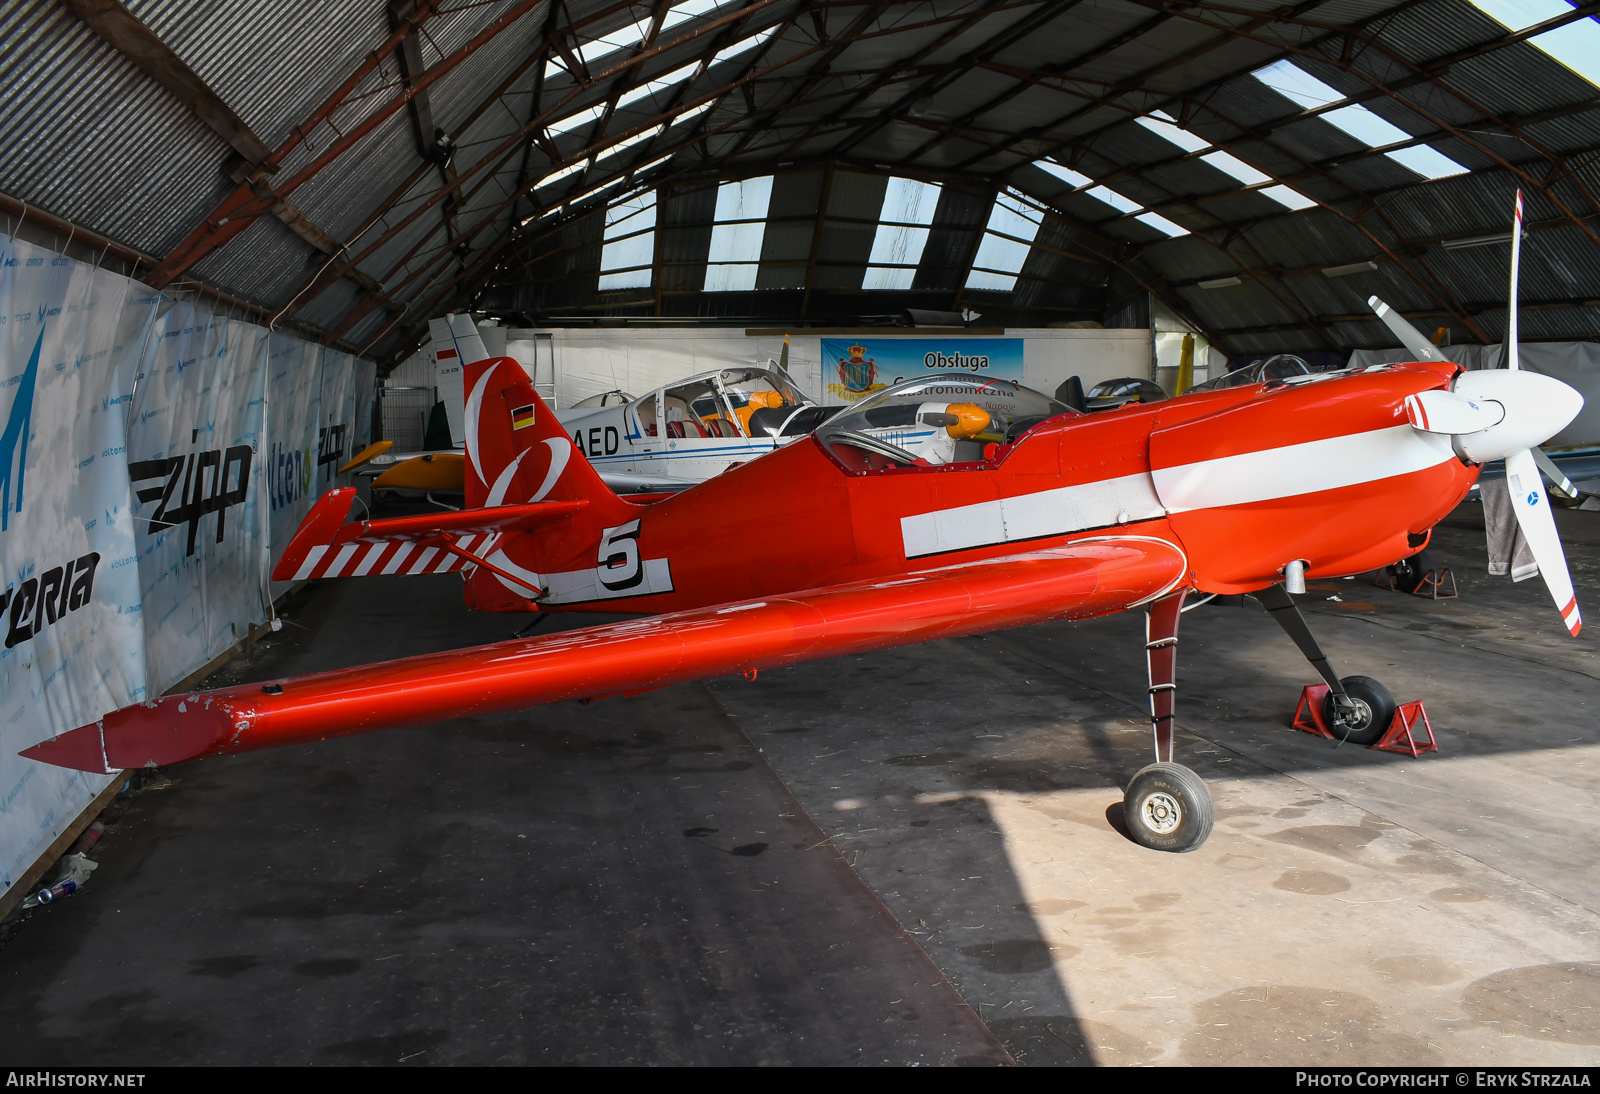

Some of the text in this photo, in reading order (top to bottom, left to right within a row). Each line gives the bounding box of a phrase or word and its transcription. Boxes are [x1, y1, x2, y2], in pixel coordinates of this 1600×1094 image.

[924, 352, 989, 371] Obsługa
[985, 402, 1016, 412] Napoje
[574, 426, 619, 457] AED
[267, 441, 311, 512] lteno
[597, 519, 643, 591] 5
